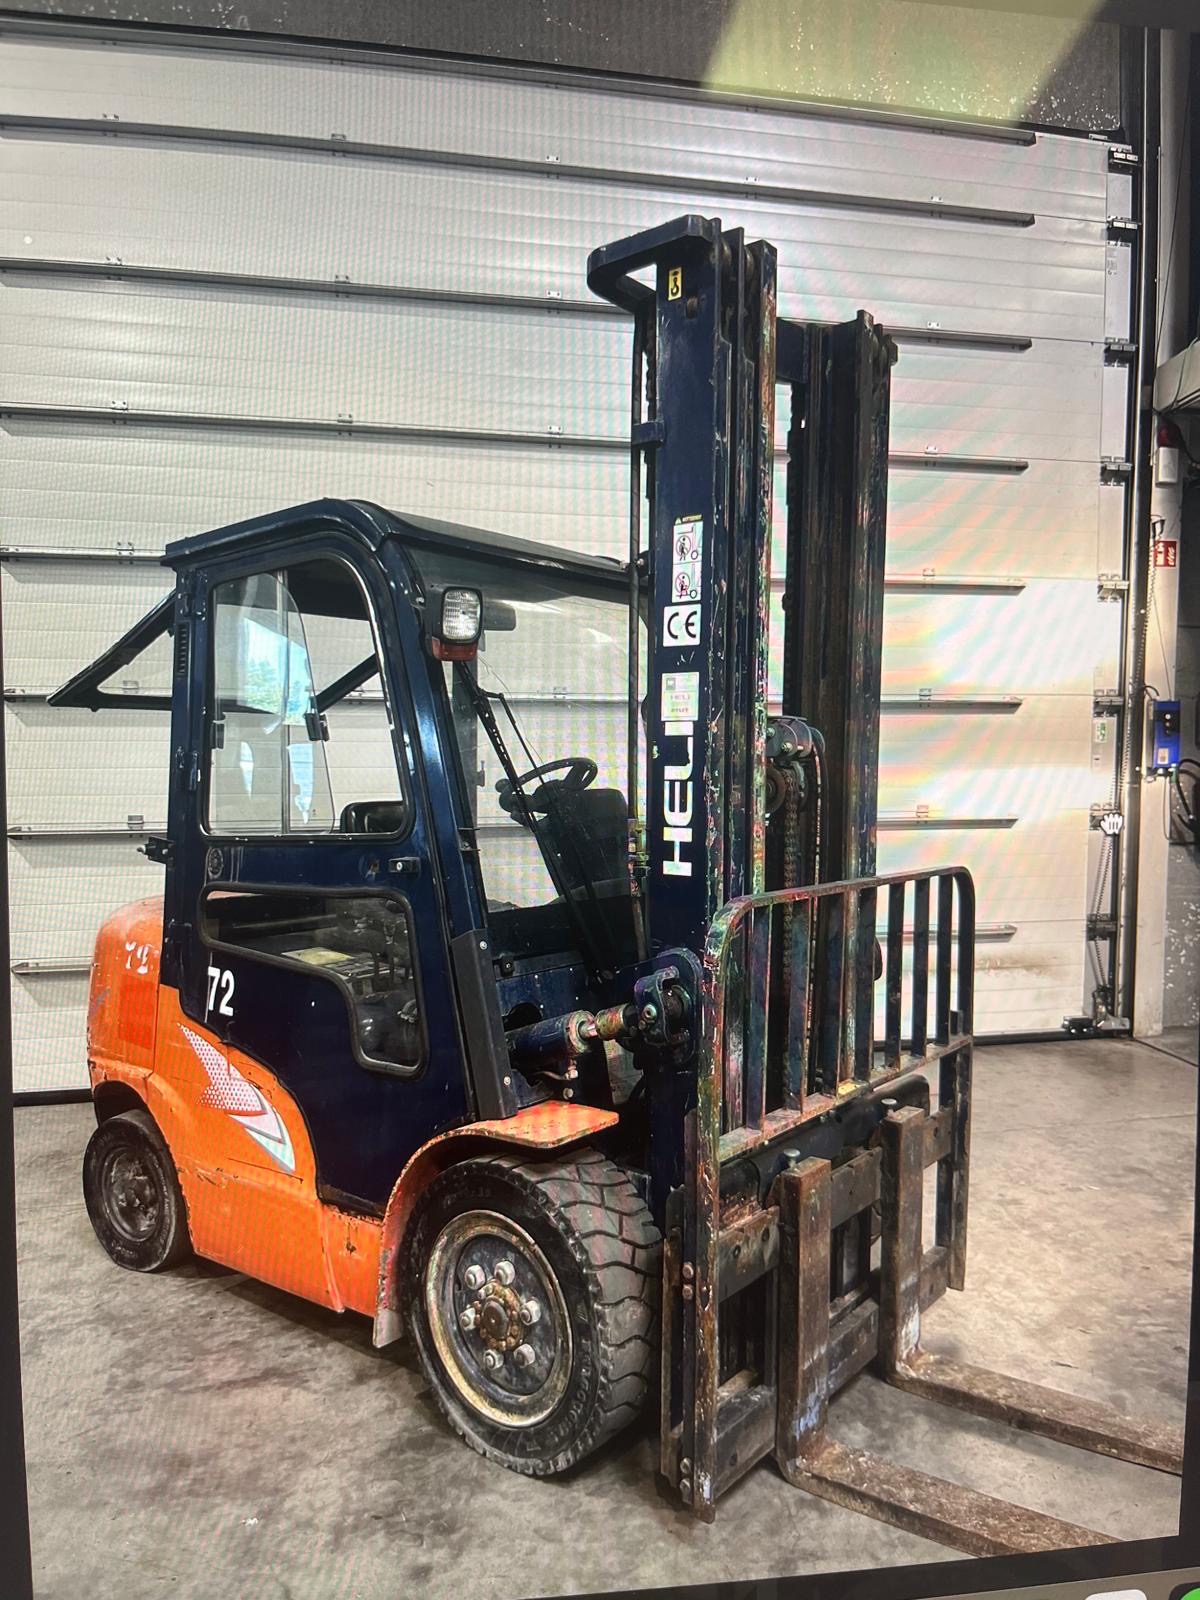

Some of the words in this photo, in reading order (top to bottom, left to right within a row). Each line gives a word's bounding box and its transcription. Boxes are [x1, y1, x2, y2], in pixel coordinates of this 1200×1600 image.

[667, 610, 698, 640] CE
[663, 721, 694, 877] HELI
[207, 965, 236, 1017] 72
